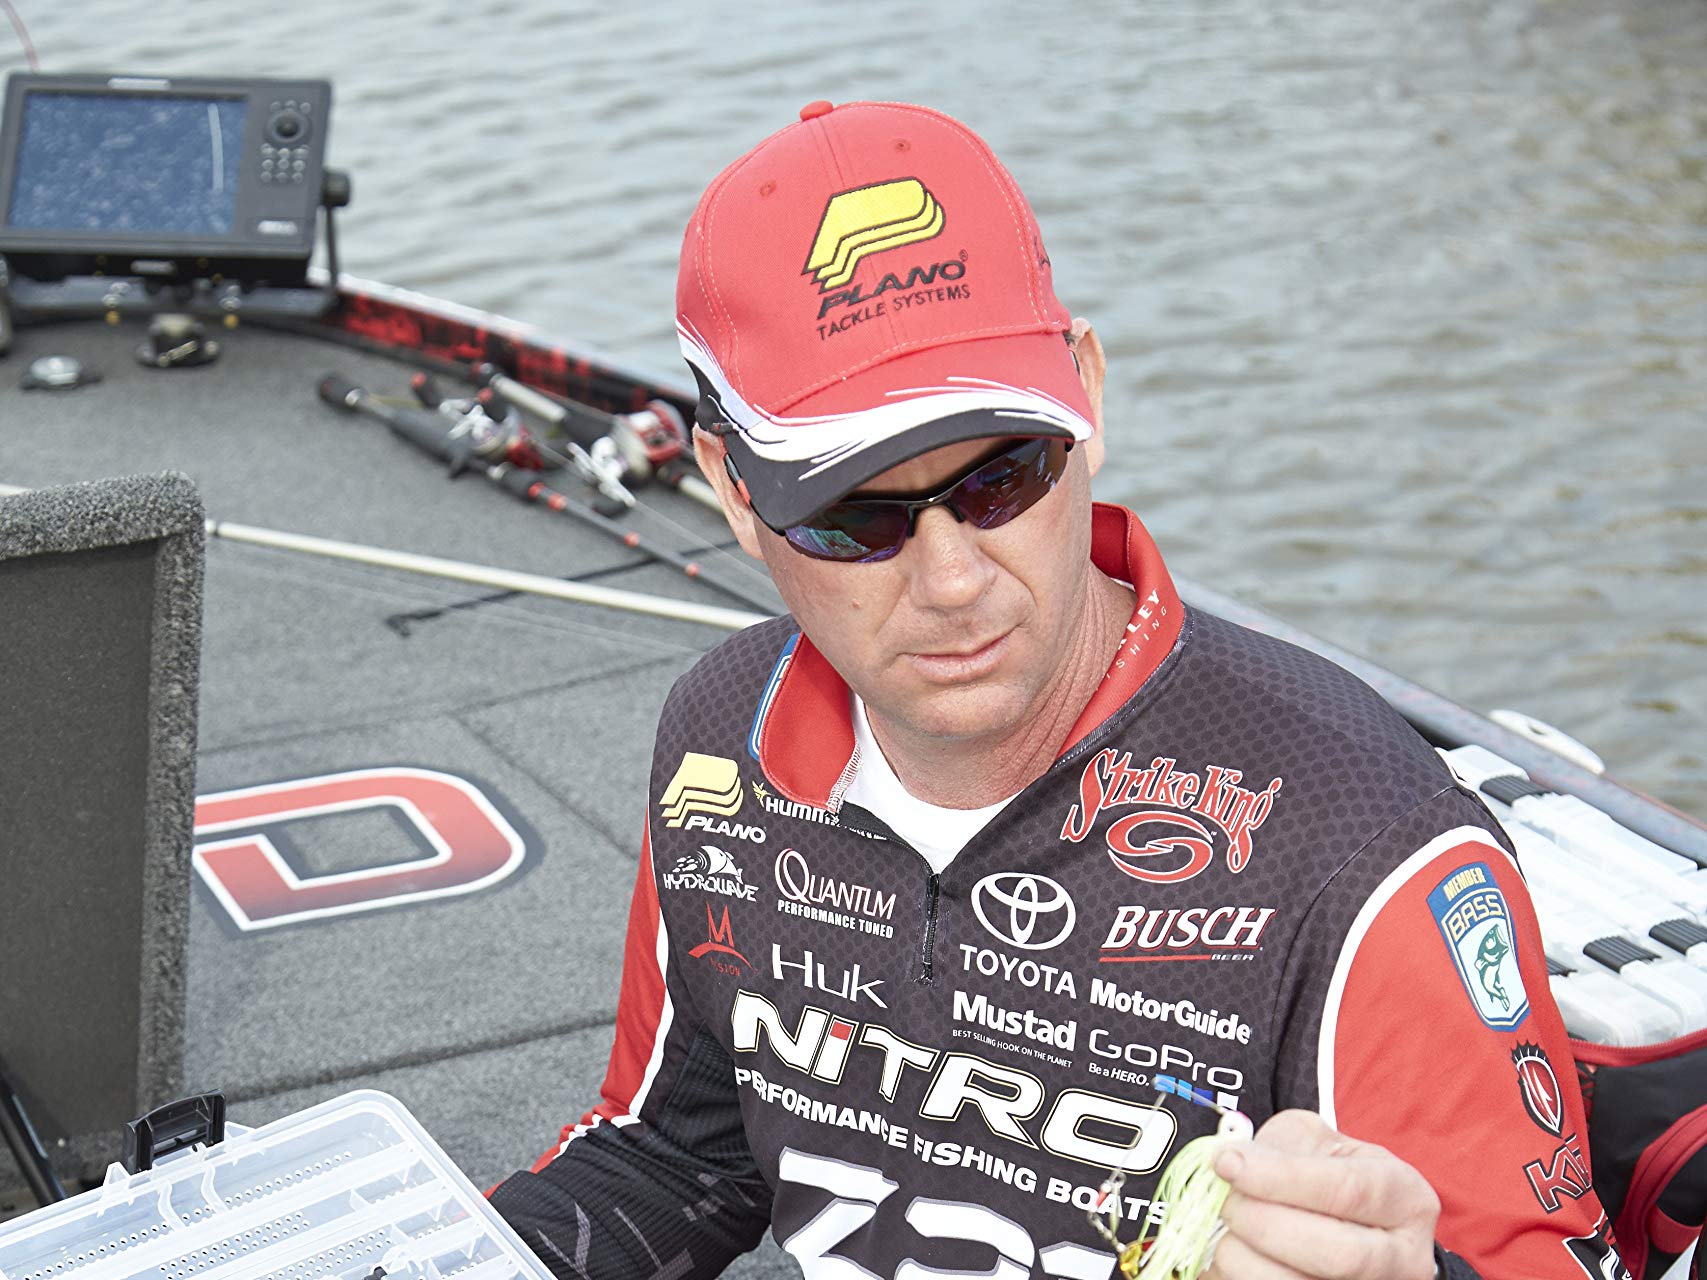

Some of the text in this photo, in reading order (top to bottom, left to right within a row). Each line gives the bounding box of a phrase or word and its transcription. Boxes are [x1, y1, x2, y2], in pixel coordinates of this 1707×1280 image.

[816, 283, 971, 341] TACKLE SYSTEMS
[817, 259, 966, 319] PLANO
[685, 815, 767, 844] PLANO
[1060, 747, 1283, 874] Strike King
[663, 872, 760, 902] HYDROWAVE
[774, 847, 897, 920] QUANTUM
[1442, 866, 1487, 902] MEMBER
[777, 899, 895, 939] PERFORMANCE TUNED
[1101, 905, 1281, 951] BUSCH
[959, 944, 1077, 999] TOYOTA
[1211, 953, 1255, 961] BEER
[952, 989, 1077, 1052] Mustad
[1089, 977, 1252, 1045] MotorGuide
[952, 1029, 1073, 1068] BEST SELLING HOOK ON THE PLANET
[1088, 1029, 1244, 1091] GoPro
[1088, 1062, 1101, 1075] Be
[1102, 1067, 1110, 1078] a
[913, 1133, 1038, 1194] FISHING
[1045, 1176, 1172, 1226] BOATS
